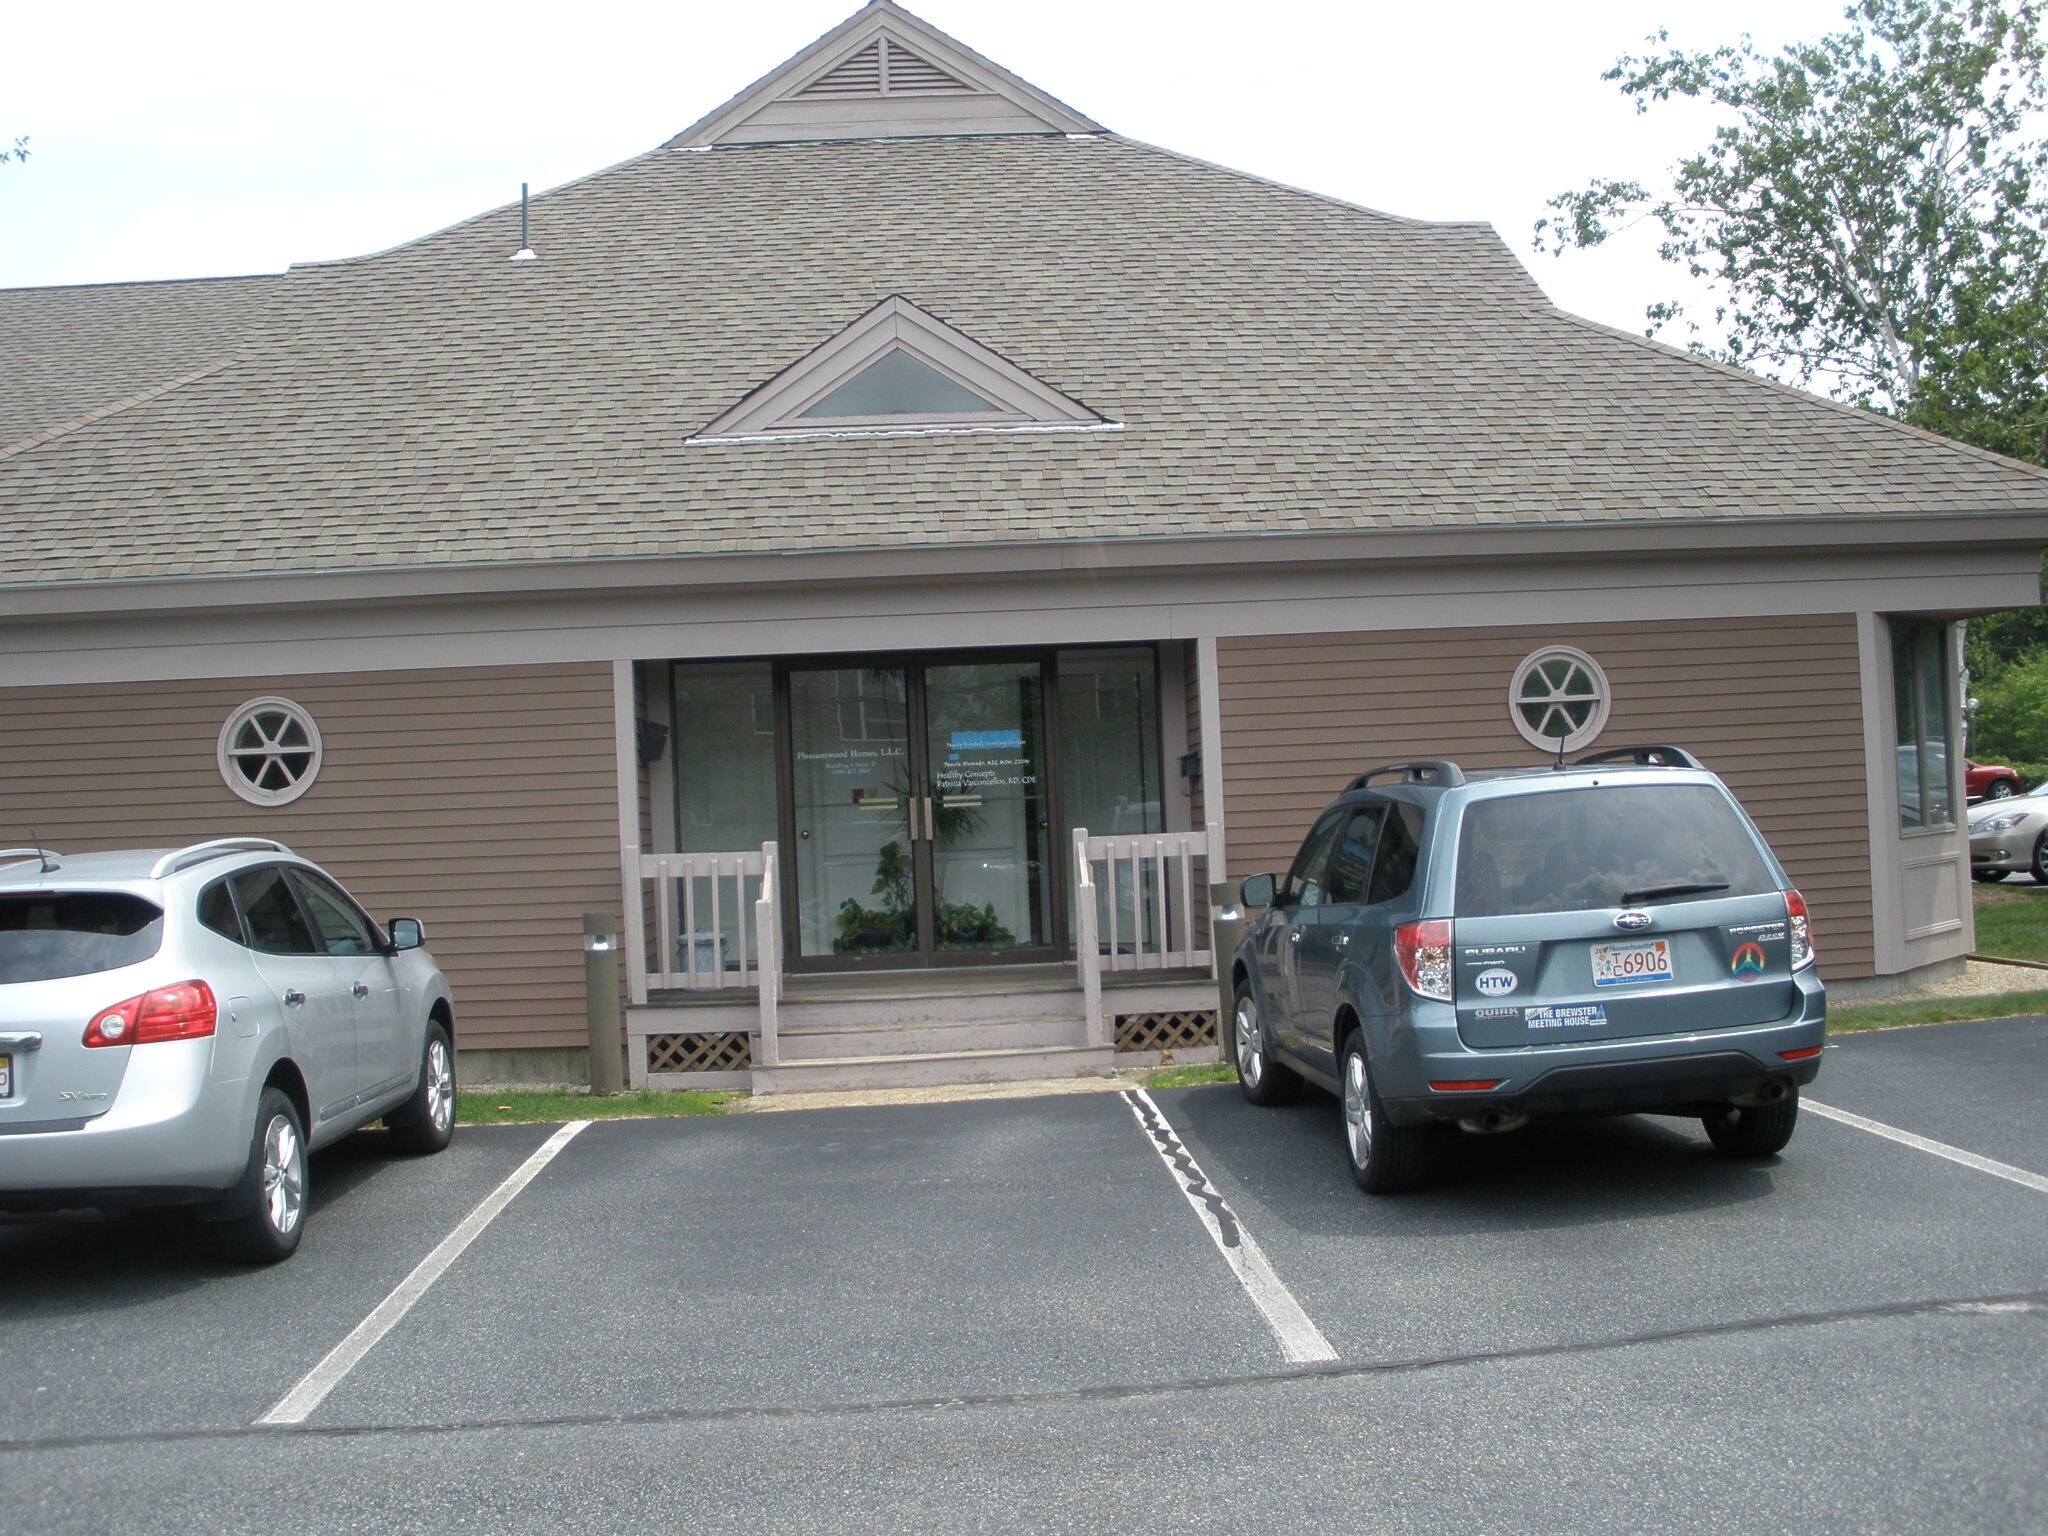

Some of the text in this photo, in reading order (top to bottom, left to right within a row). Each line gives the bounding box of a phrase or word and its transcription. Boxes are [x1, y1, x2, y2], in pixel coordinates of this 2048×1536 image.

[797, 751, 848, 760] Pleasantwood
[850, 749, 878, 758] Homes,
[937, 769, 996, 780] Healthy Concepts
[937, 780, 962, 788] Patricia
[1022, 775, 1037, 784] CDE
[1729, 922, 1784, 935] FORESTER
[1465, 946, 1526, 956] SUBARU
[1624, 951, 1667, 974] 6906
[1479, 976, 1513, 988] HTW
[1475, 1008, 1519, 1017] QUIRK
[1539, 1009, 1554, 1019] THE
[1555, 1006, 1597, 1018] BREWSTER
[1528, 1018, 1563, 1029] MEETING
[1564, 1016, 1590, 1027] HOUSE
